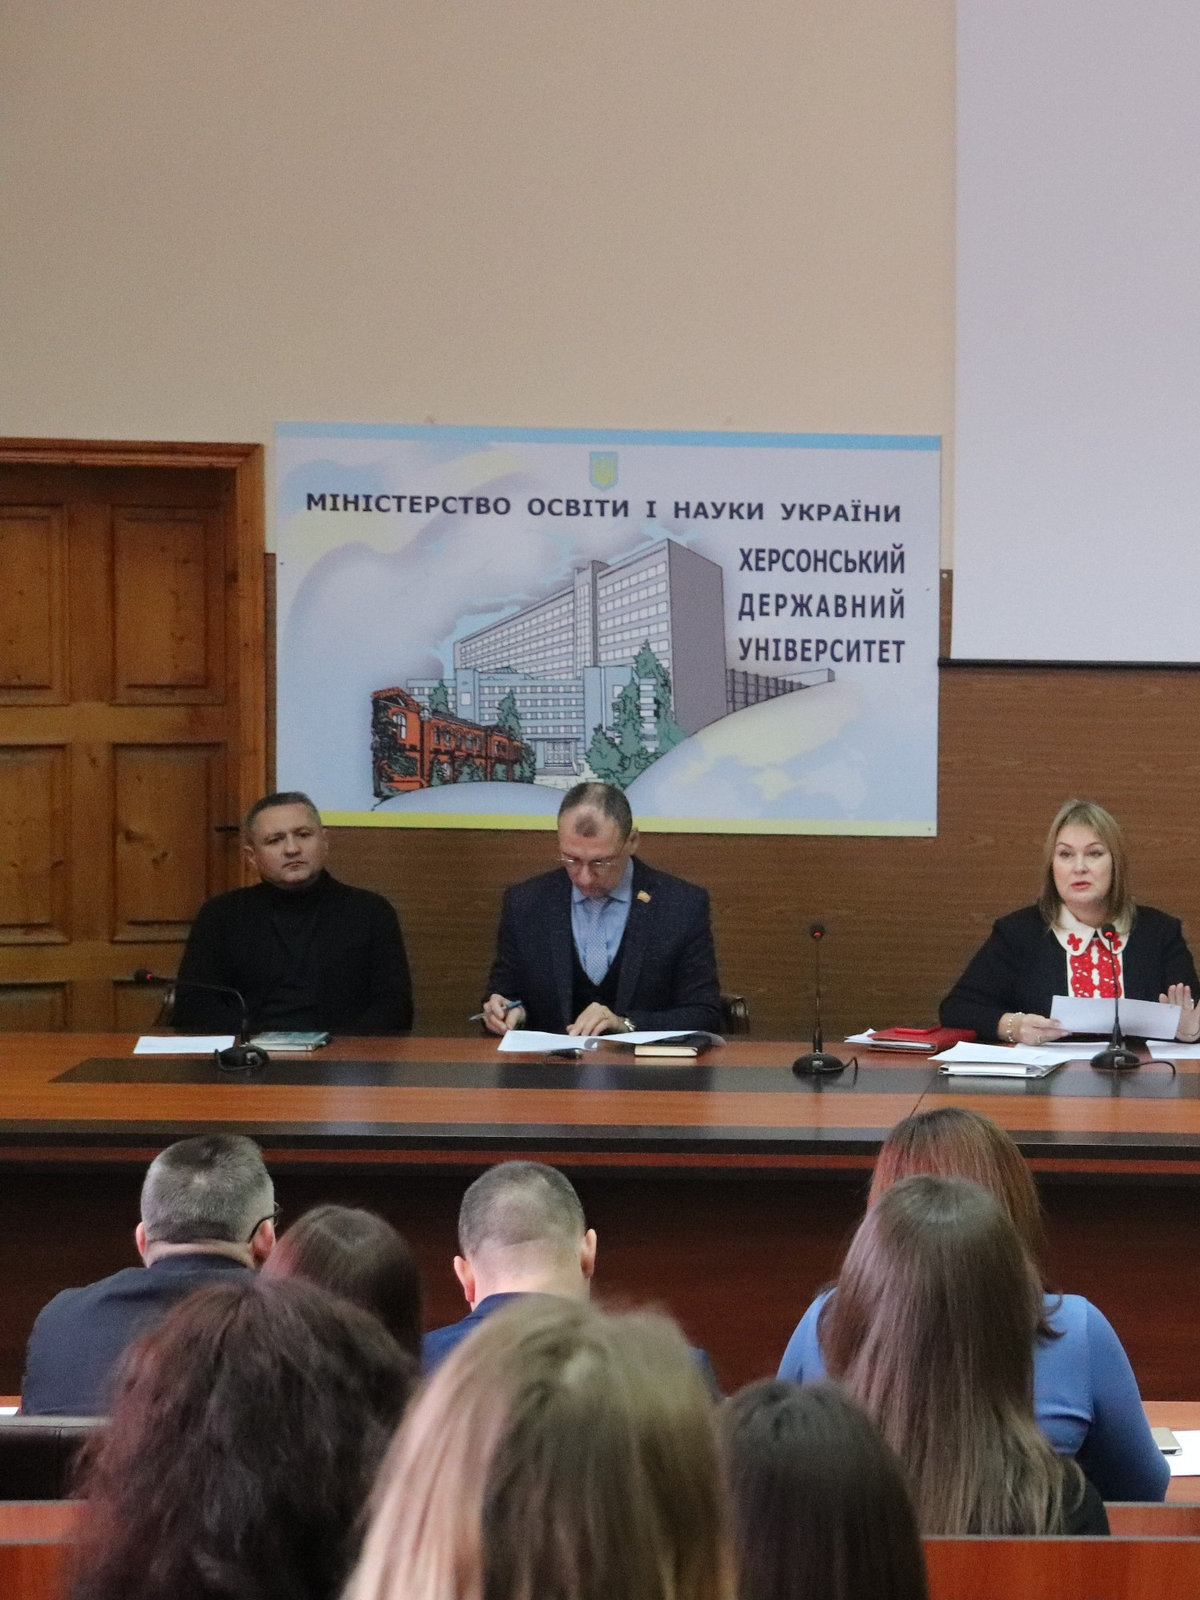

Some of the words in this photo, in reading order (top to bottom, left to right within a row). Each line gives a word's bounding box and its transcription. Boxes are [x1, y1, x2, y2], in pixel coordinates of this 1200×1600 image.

[306, 493, 511, 515] МІНІСТЕРСТВО
[527, 498, 629, 517] ОСВІТИ
[646, 500, 656, 518] І
[673, 501, 764, 520] НАУКИ
[780, 500, 901, 522] УКРАЇНИ
[739, 543, 905, 574] ХЕРСОНСЬКИЙ
[738, 588, 904, 621] ДЕРЖАВНИЙ
[738, 637, 906, 663] УНІВЕРСИТЕТ
